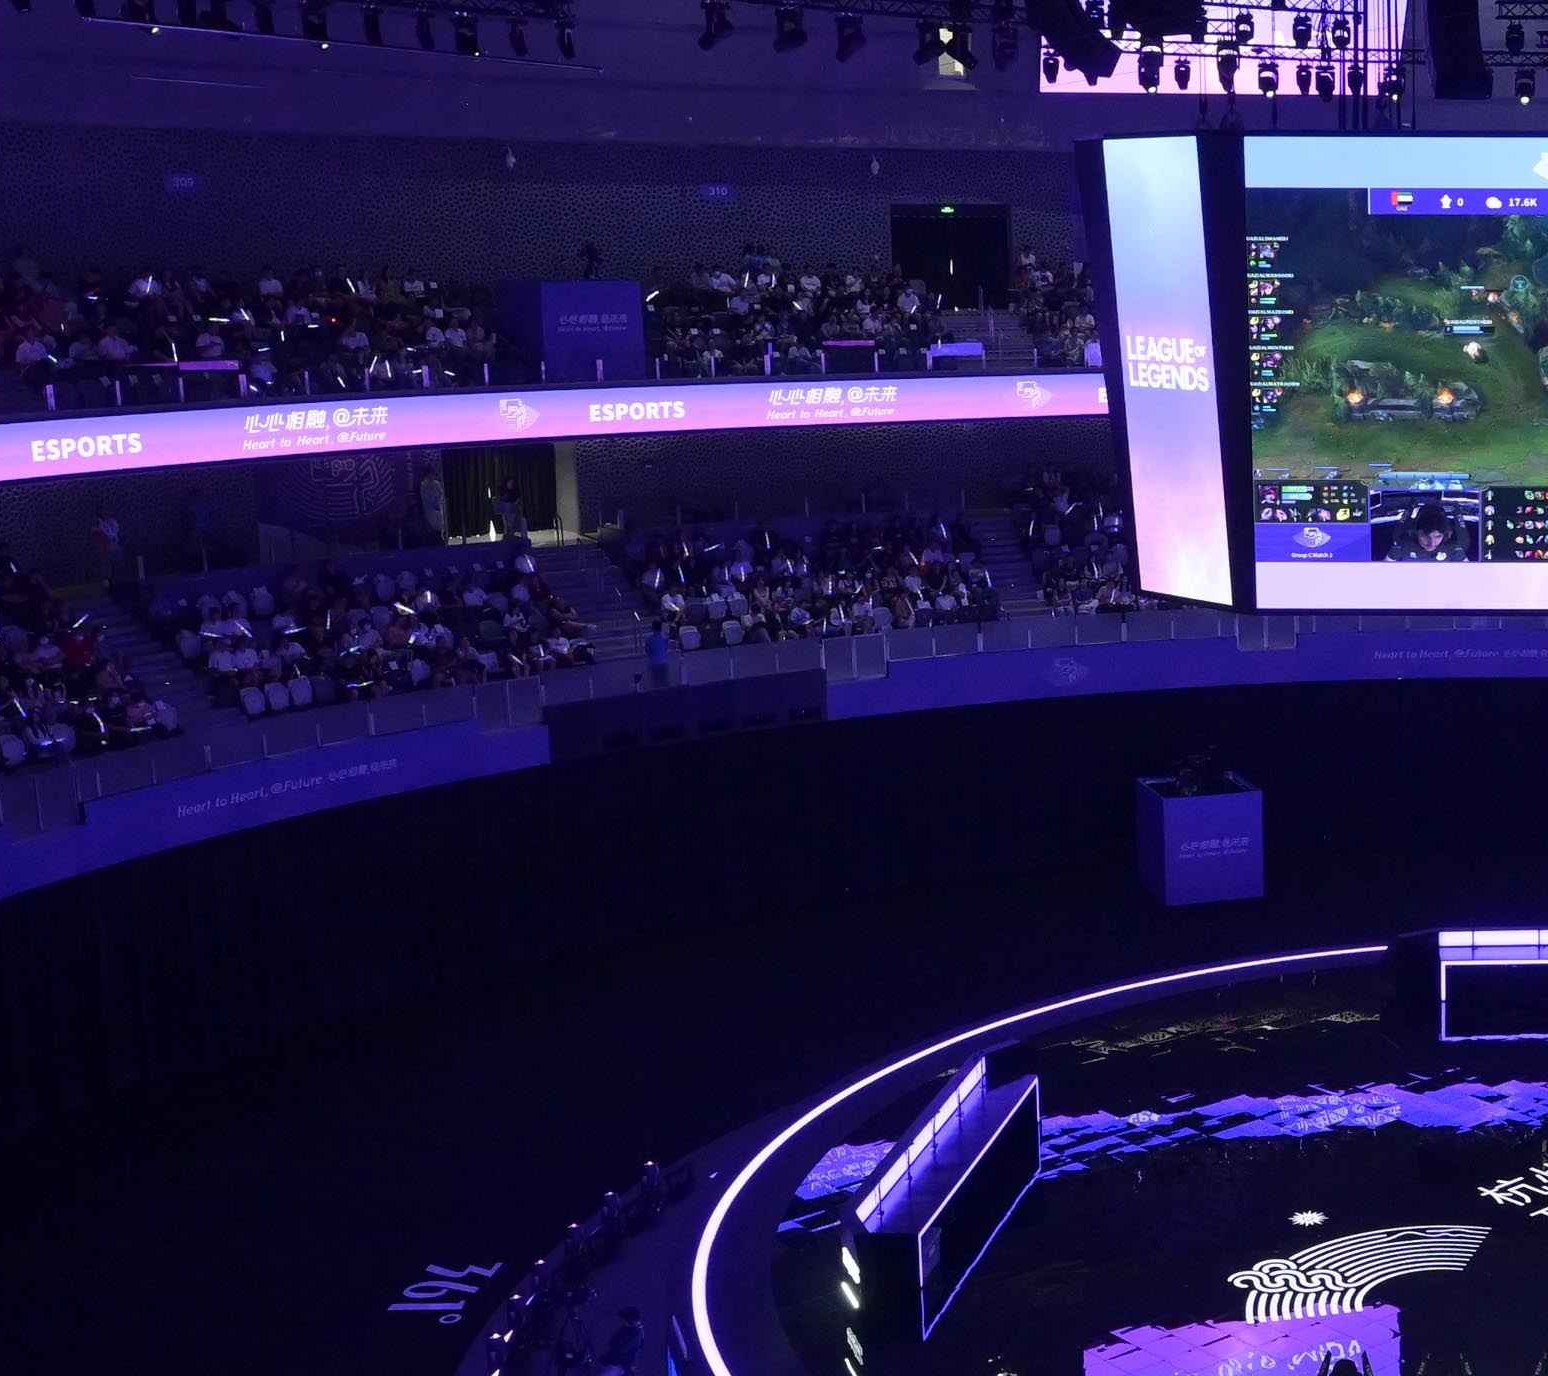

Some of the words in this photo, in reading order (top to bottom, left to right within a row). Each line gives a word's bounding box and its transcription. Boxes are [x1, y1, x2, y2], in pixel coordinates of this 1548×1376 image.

[1508, 197, 1538, 208] 17.6K
[1126, 335, 1195, 364] LEAGUE
[1129, 362, 1210, 392] LEGENDS
[589, 401, 686, 422] ESPORTS
[30, 432, 143, 463] ESPORTS
[242, 438, 275, 452] Heart
[280, 437, 292, 450] to
[337, 431, 386, 445] @Future
